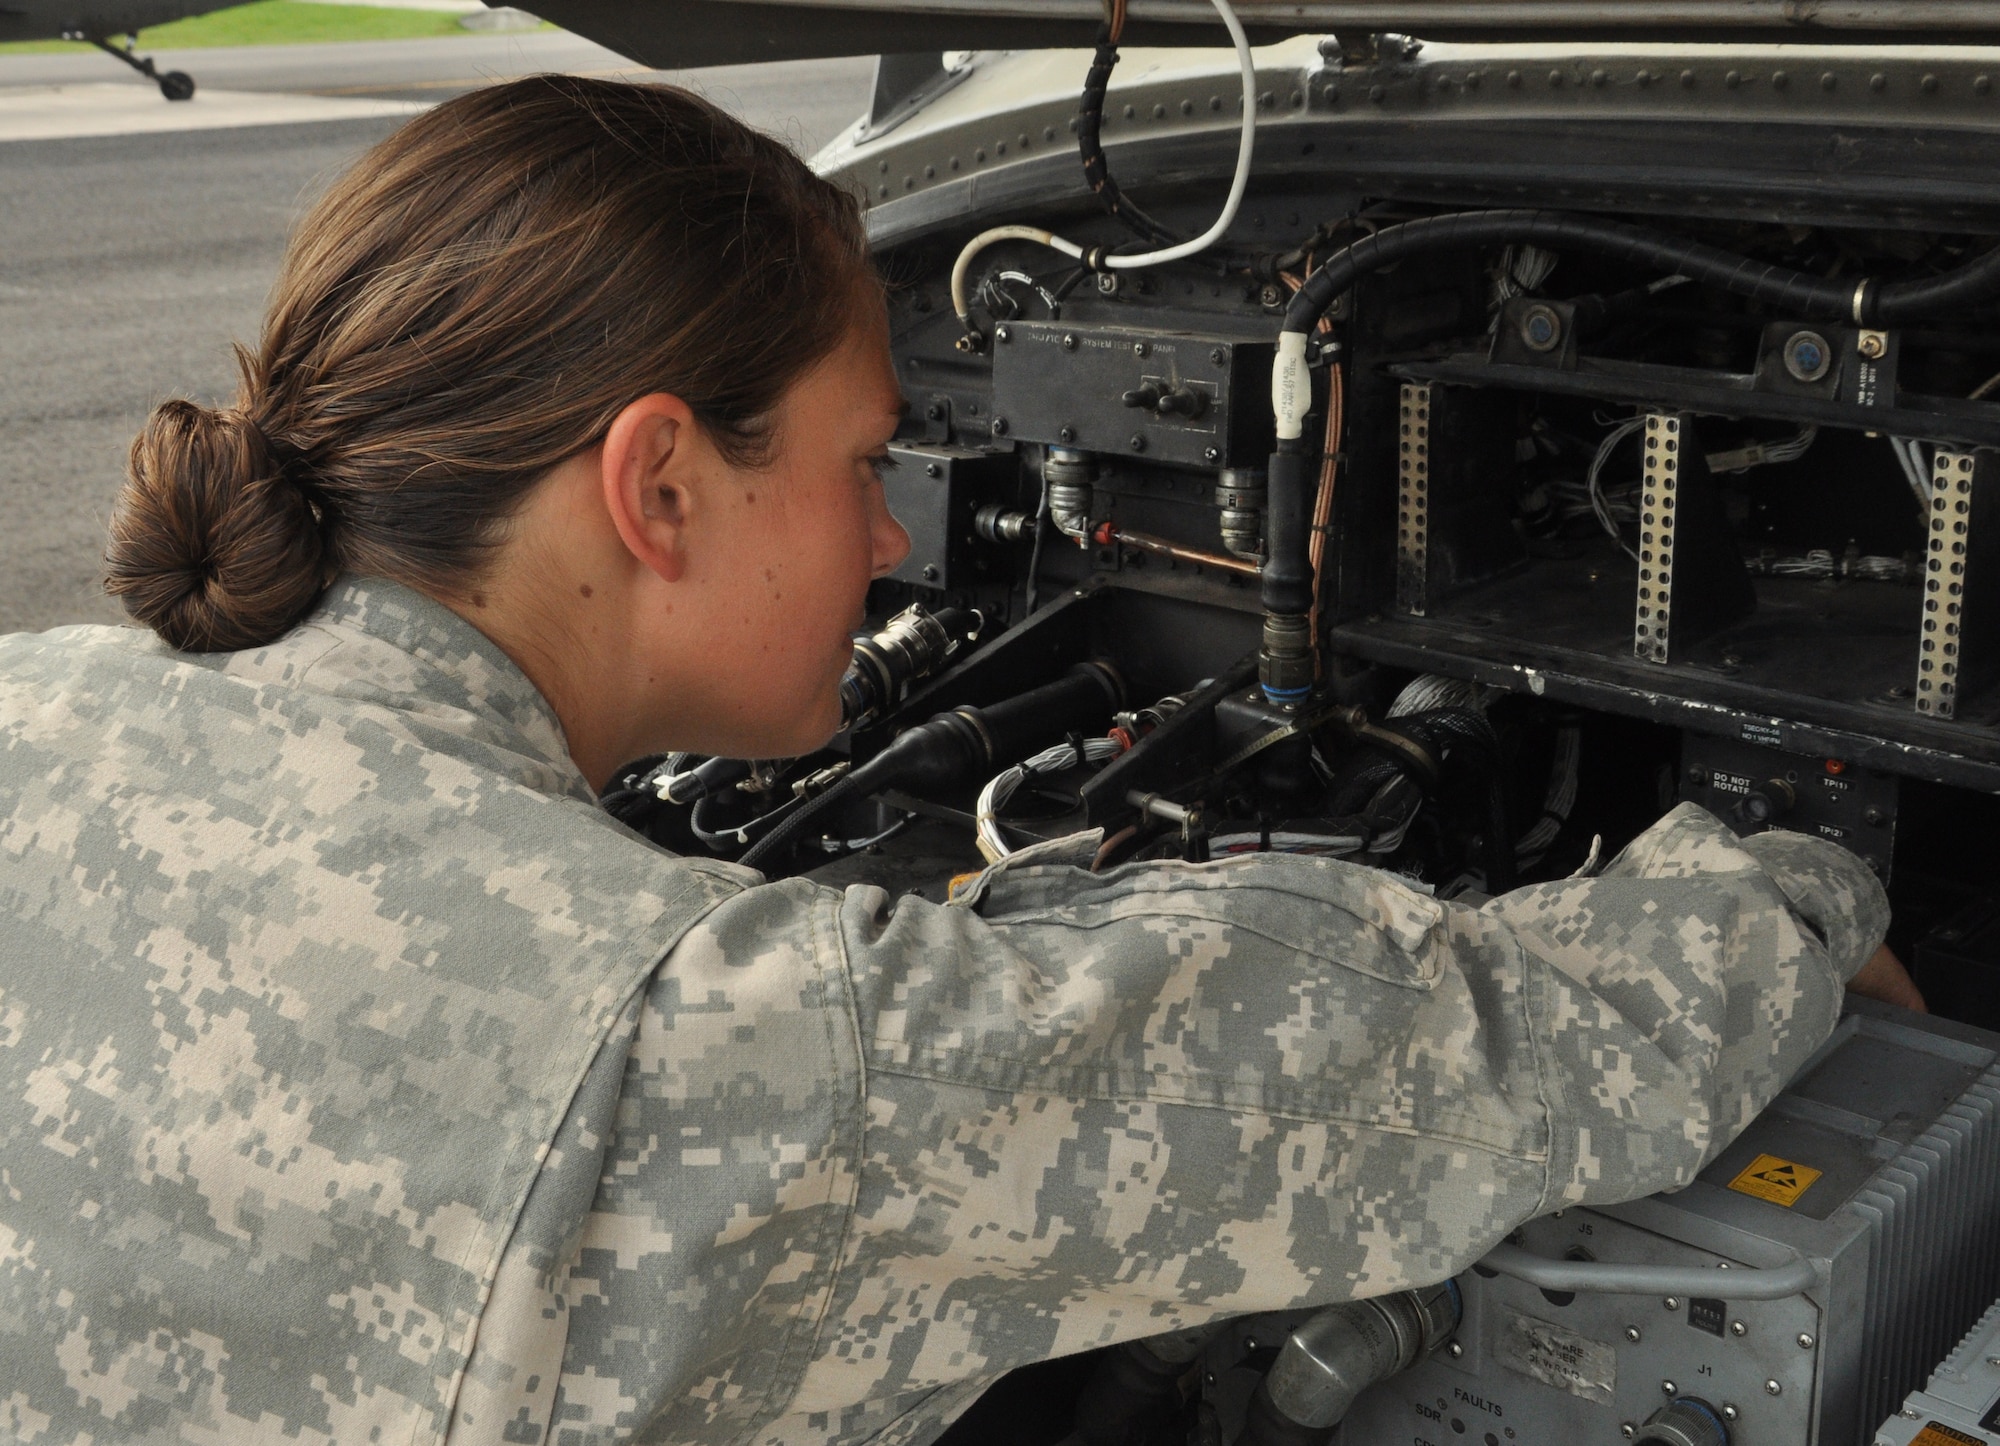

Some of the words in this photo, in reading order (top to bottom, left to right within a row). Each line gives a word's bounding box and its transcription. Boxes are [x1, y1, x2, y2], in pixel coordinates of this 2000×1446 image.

[1714, 772, 1728, 782] DO
[1731, 776, 1751, 787] NOT
[1824, 778, 1849, 791] TP(1)
[1713, 781, 1750, 795] ROTATE
[1819, 825, 1843, 838] TP(2)
[1578, 1223, 1593, 1235] J5
[1697, 1364, 1712, 1377] J1
[1454, 1387, 1503, 1417] FAULTS
[1415, 1403, 1442, 1423] SDR
